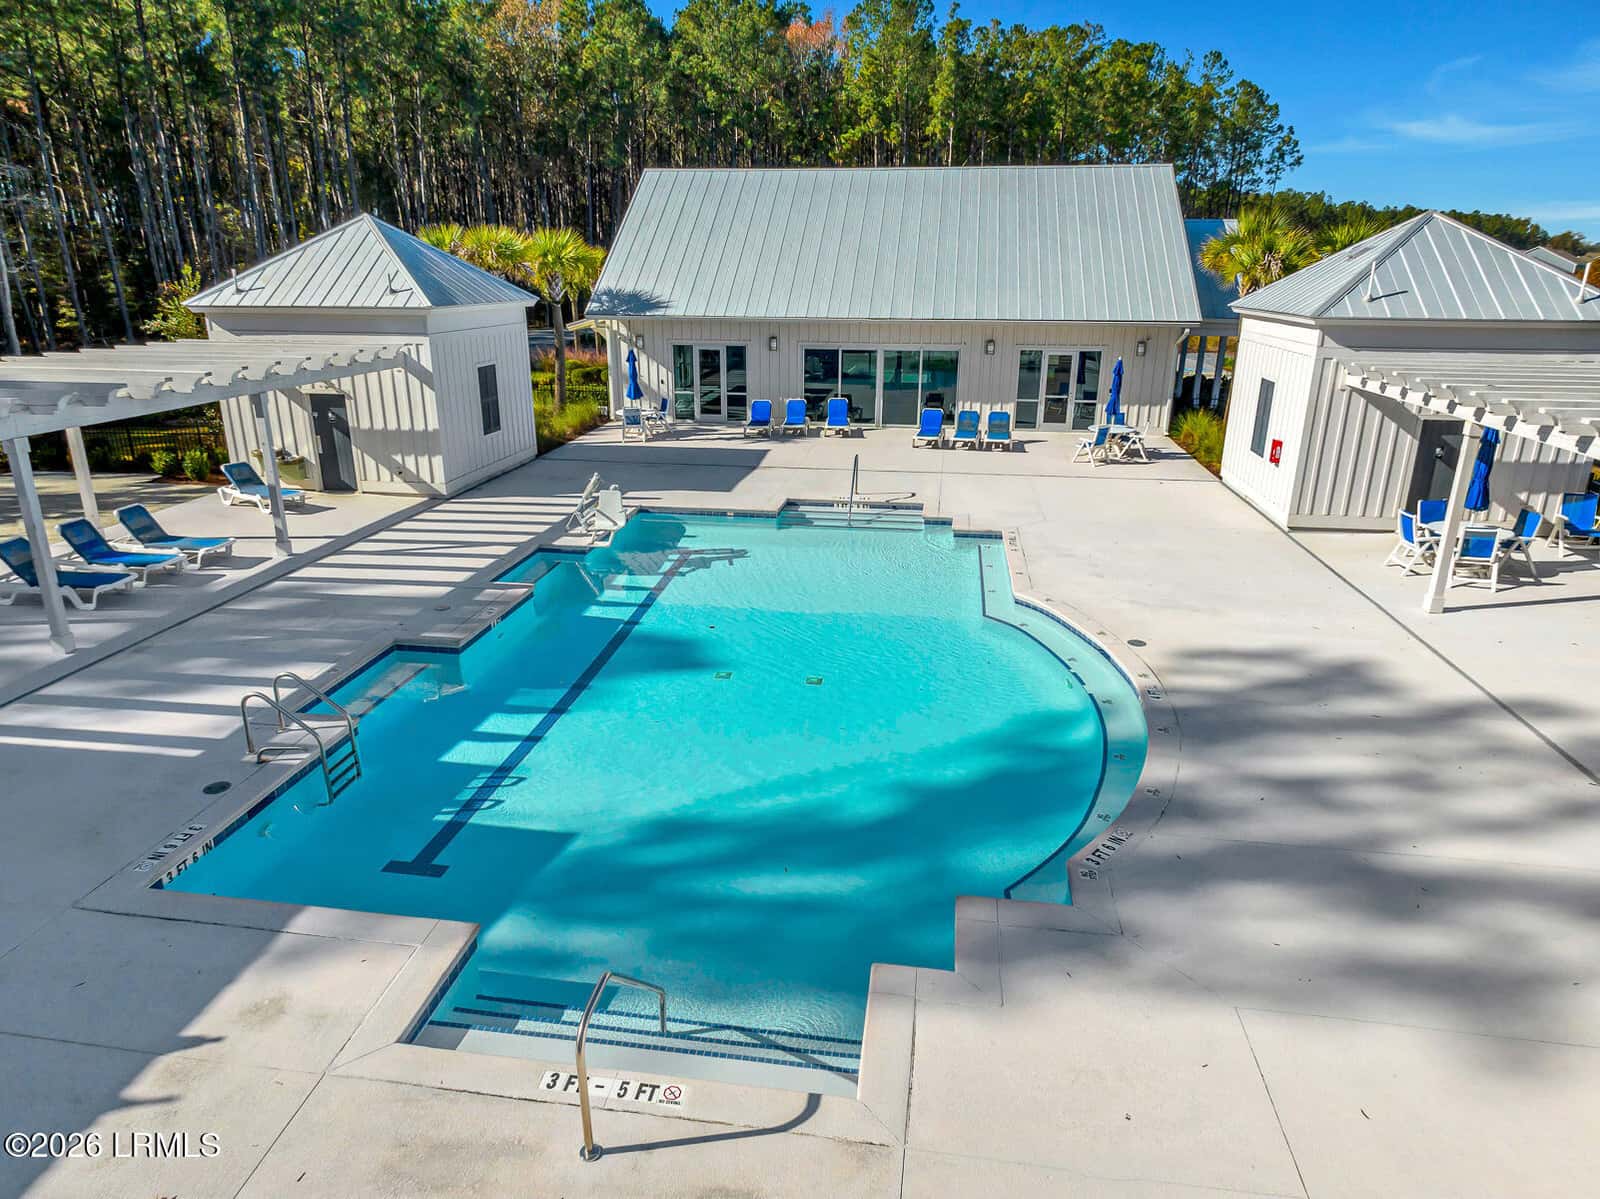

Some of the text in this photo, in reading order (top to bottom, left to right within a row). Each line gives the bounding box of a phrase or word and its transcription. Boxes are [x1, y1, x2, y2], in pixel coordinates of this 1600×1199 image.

[174, 832, 195, 842] FT
[1106, 833, 1126, 846] IN
[1101, 843, 1116, 851] 6
[147, 851, 169, 861] IN
[1091, 848, 1111, 861] FT
[166, 839, 213, 884] 3 FT 6 IN
[1085, 857, 1100, 866] 3
[546, 1072, 560, 1090] 3
[563, 1075, 590, 1094] F
[616, 1081, 630, 1099] 5
[634, 1083, 660, 1102] FT
